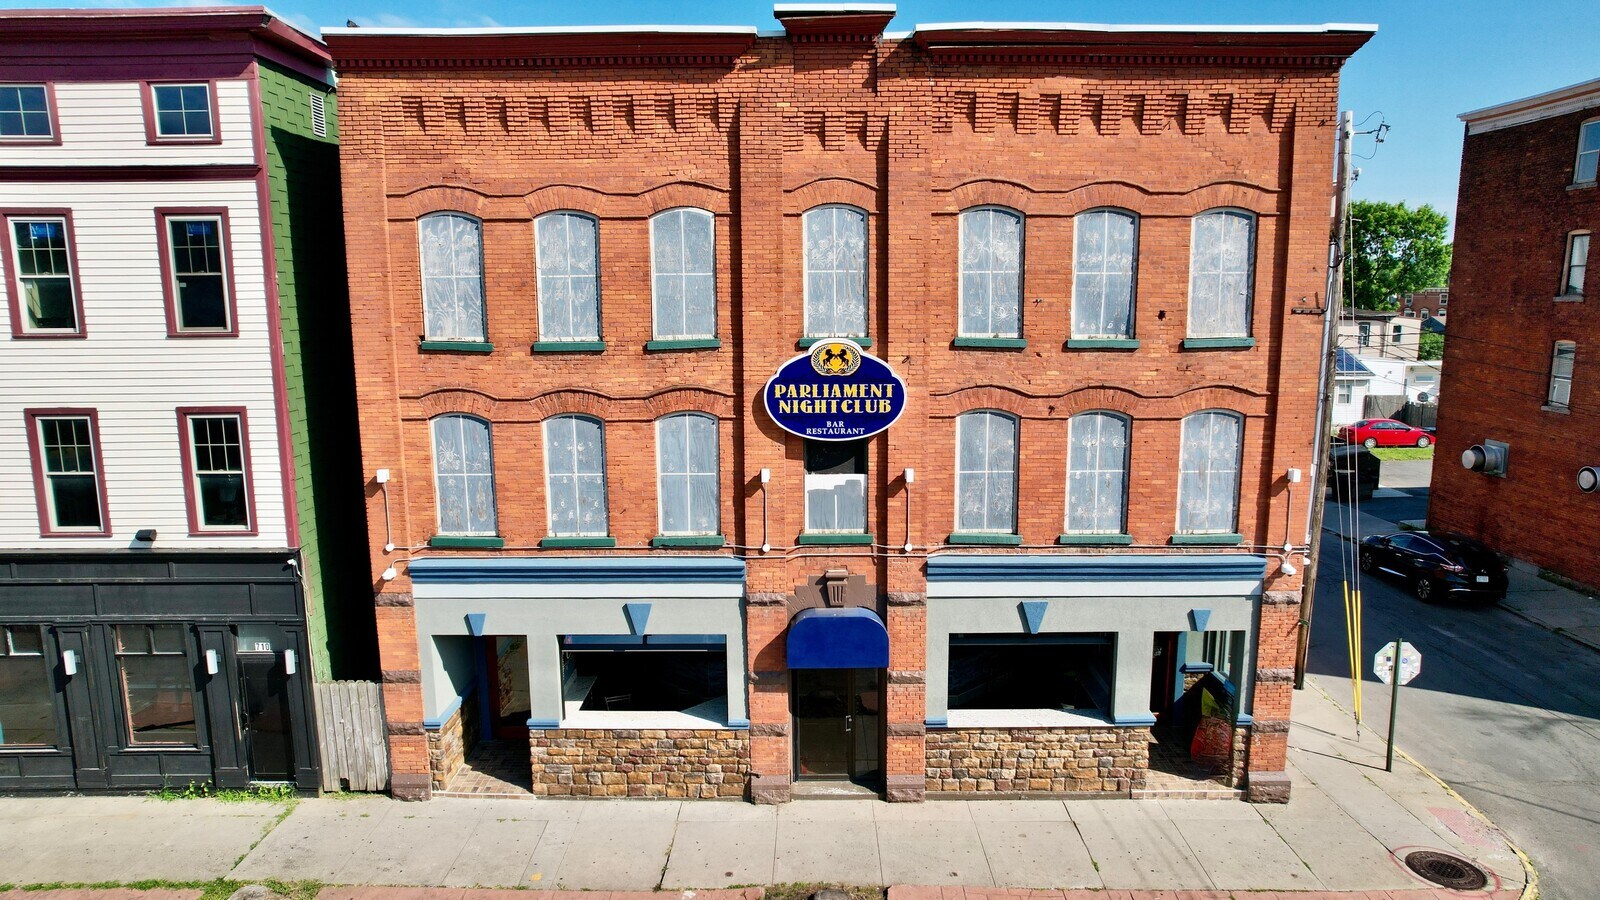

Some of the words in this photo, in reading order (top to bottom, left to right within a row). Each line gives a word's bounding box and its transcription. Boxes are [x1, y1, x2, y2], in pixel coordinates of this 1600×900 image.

[774, 383, 896, 398] PARLIAMENT
[778, 399, 891, 414] NIGHTCLUB
[806, 427, 865, 435] RESTAURANT
[255, 642, 270, 650] 710
